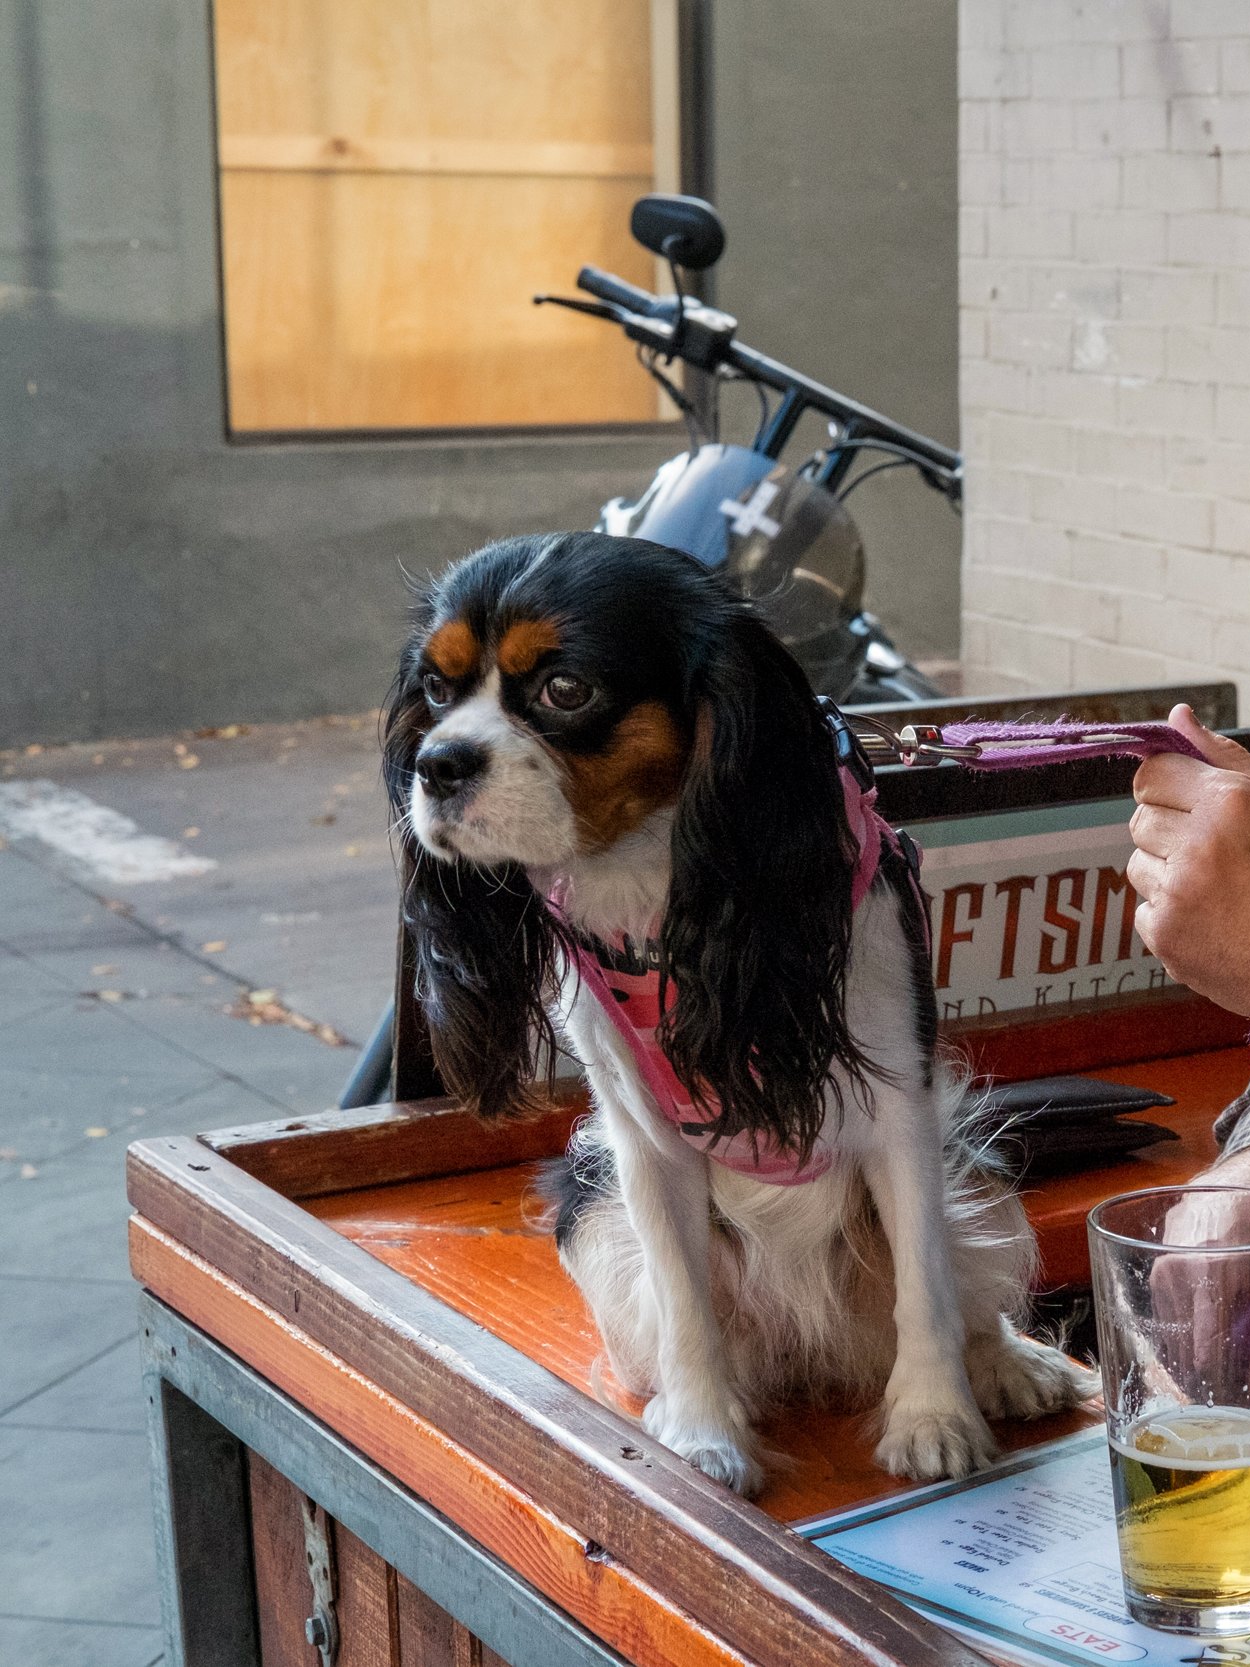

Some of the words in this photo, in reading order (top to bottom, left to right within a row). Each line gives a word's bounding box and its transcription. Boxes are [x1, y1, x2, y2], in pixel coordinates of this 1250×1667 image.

[926, 866, 1152, 990] FTSM
[952, 1543, 981, 1555] Eggs
[951, 1558, 991, 1574] SNACKS
[973, 1551, 1011, 1567] Deviled
[948, 1580, 990, 1597] 10pm
[980, 1594, 1008, 1605] until
[1049, 1623, 1122, 1653] EATS
